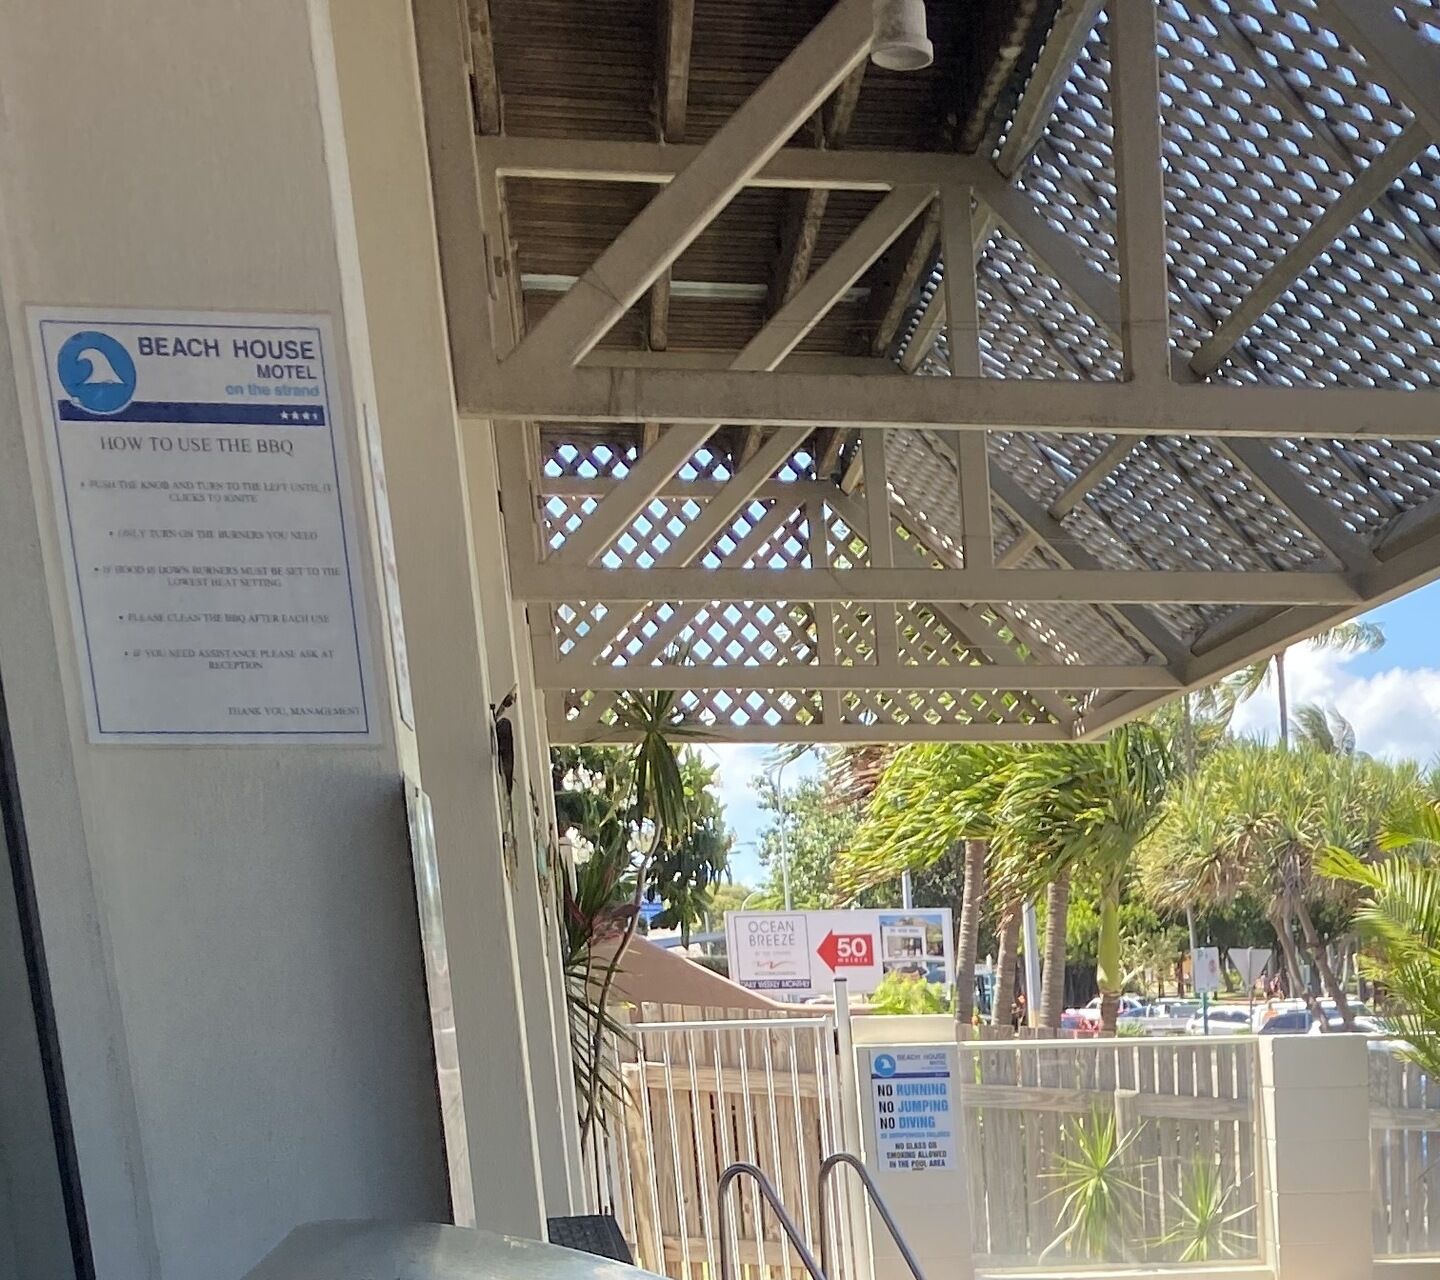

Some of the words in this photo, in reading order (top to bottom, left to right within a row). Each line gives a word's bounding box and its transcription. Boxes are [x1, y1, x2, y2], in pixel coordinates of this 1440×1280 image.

[137, 336, 220, 357] BEACH
[233, 339, 314, 360] HOUSE
[256, 364, 317, 380] MOTEL
[225, 385, 243, 396] on
[247, 384, 271, 396] the
[274, 384, 320, 397] strand
[100, 436, 143, 450] HOW
[148, 437, 173, 451] TO
[178, 437, 211, 452] USE
[216, 438, 250, 453] THE
[256, 439, 294, 456] BBQ
[127, 613, 163, 623] PLEASE
[167, 613, 201, 623] CLEAN
[203, 613, 221, 623] THE
[224, 614, 246, 624] BBQ
[248, 614, 279, 623] AFTER
[281, 614, 309, 624] EACH
[311, 615, 330, 624] USE
[208, 661, 263, 670] RECEPTION
[228, 707, 261, 716] THANK
[290, 707, 360, 717] MANAGEMENT
[747, 920, 795, 933] OCEAN
[749, 933, 796, 947] BREEZE
[837, 937, 867, 957] 50
[877, 1084, 893, 1096] NO
[896, 1083, 947, 1096] RUNNING
[879, 1101, 894, 1113] NO
[898, 1100, 948, 1112] JUMPING
[880, 1117, 895, 1129] NO
[899, 1116, 935, 1128] DIVING
[895, 1142, 904, 1150] NO
[928, 1141, 937, 1149] OR
[886, 1151, 915, 1159] SMOKING
[917, 1150, 947, 1158] ALLOWED
[898, 1160, 909, 1168] THE
[911, 1160, 927, 1168] POOL
[929, 1159, 945, 1167] AREA
